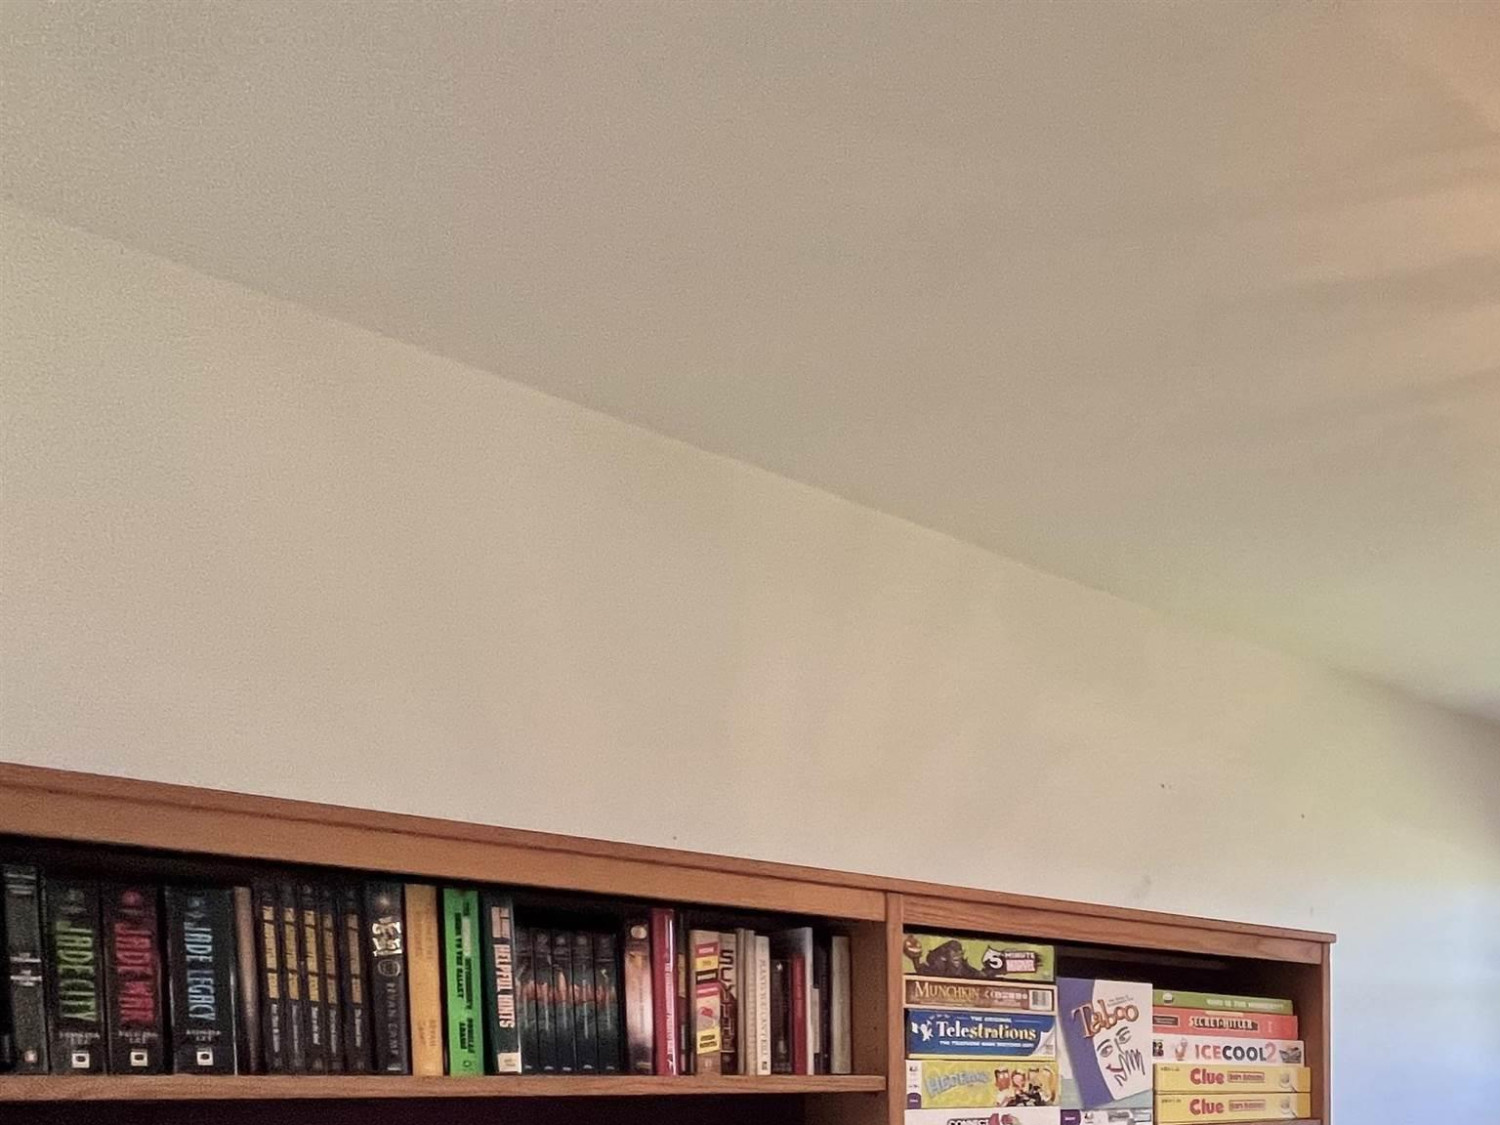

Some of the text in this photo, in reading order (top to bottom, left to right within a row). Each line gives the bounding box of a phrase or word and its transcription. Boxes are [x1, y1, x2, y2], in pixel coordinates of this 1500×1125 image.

[56, 921, 95, 975] JADE
[114, 922, 153, 976] JADE
[184, 921, 213, 962] JADE
[493, 944, 514, 991] HELPFUL
[58, 979, 97, 1022] CITY
[186, 968, 217, 1021] LEGACY
[914, 981, 981, 1000] MUNCHKIN
[497, 994, 515, 1029] HINTS
[935, 1020, 1037, 1041] Telestrations
[1071, 998, 1139, 1040] Taboo
[1189, 1068, 1225, 1086] Clue
[1189, 1099, 1225, 1116] Clue
